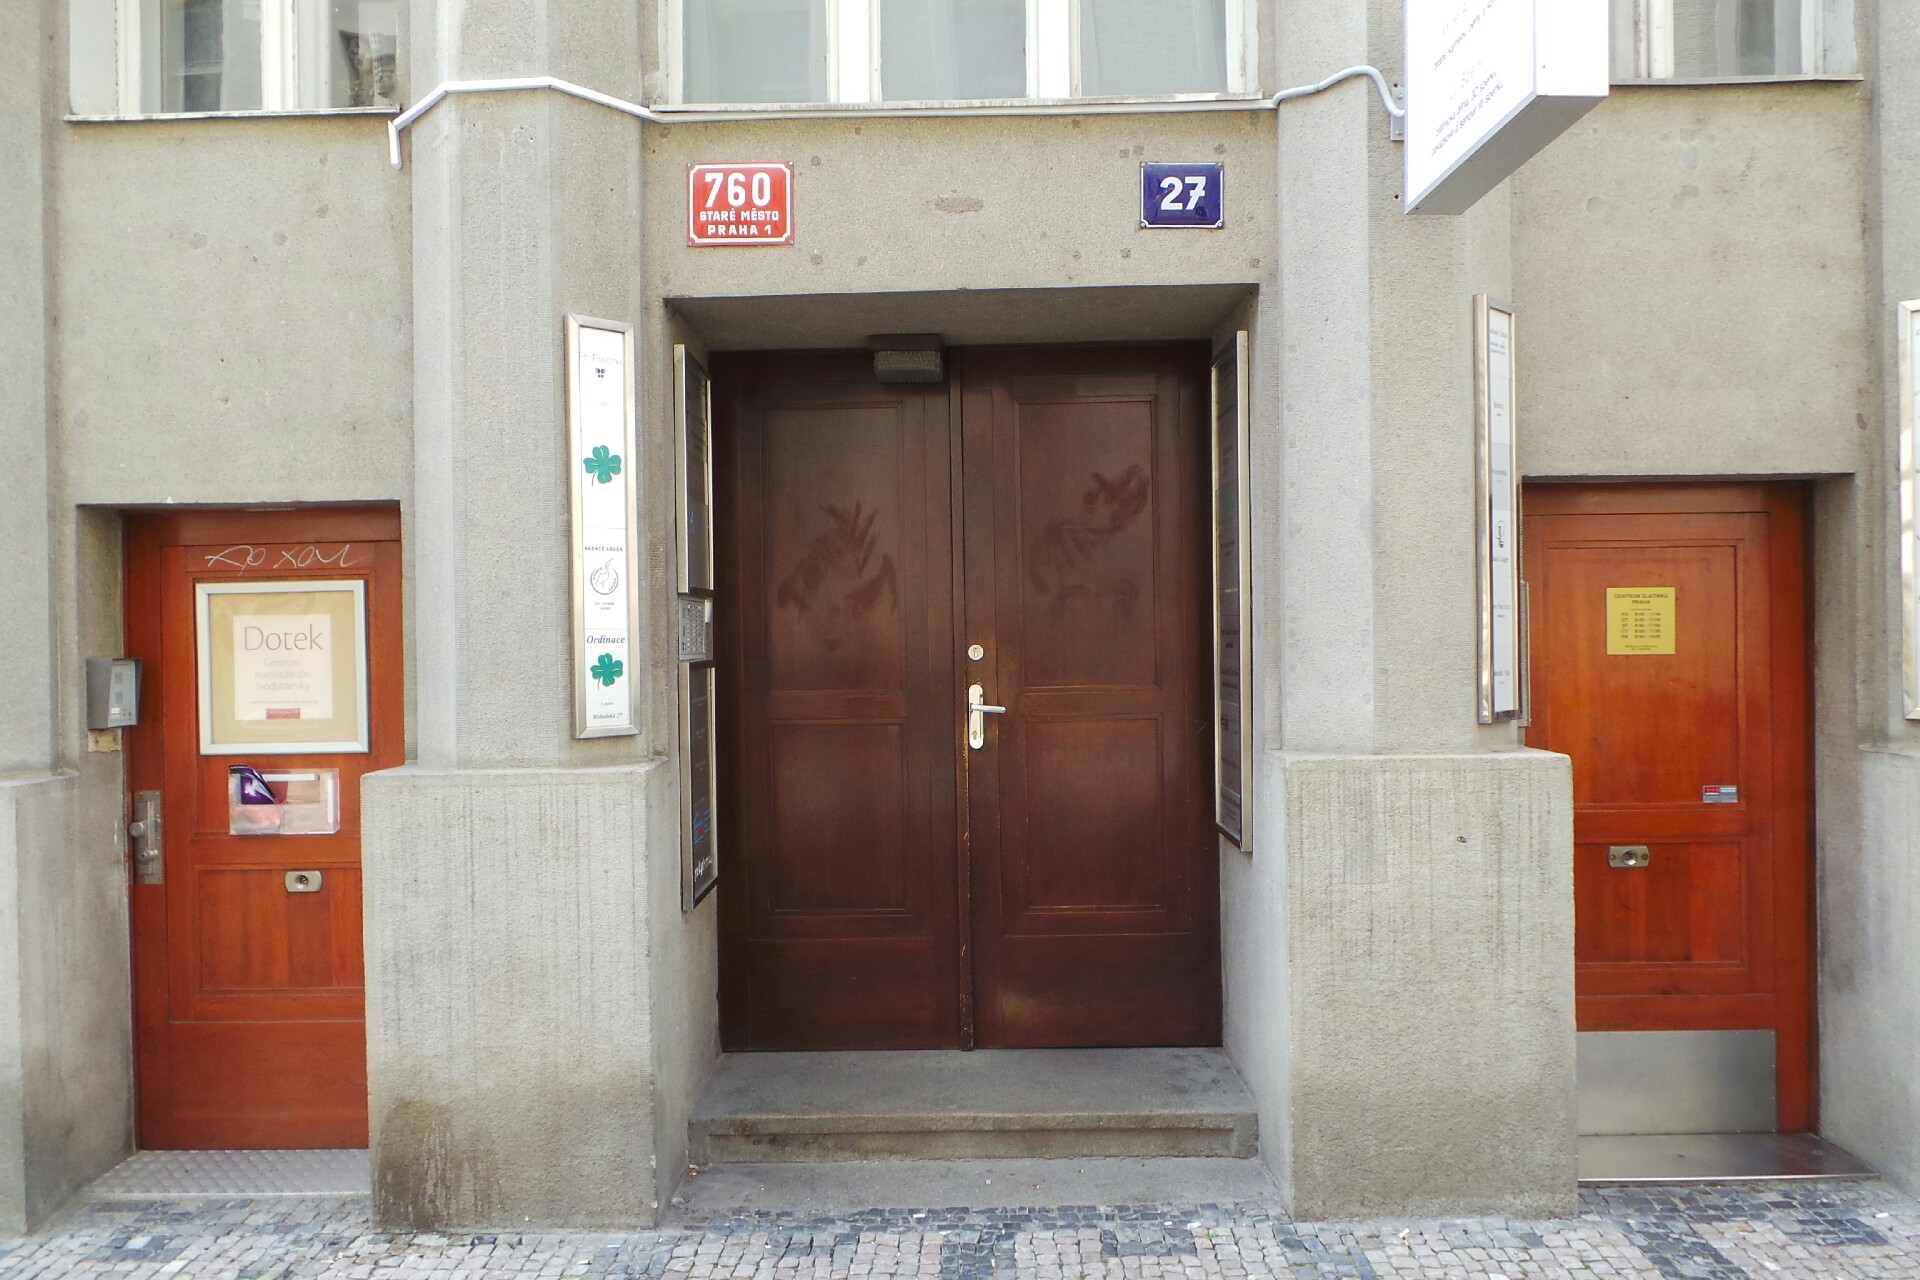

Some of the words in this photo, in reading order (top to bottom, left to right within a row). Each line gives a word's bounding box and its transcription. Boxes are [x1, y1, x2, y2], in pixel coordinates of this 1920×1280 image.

[705, 172, 771, 208] 760
[1160, 176, 1206, 210] 27
[699, 208, 736, 221] STARÉ
[707, 224, 759, 236] PRAHA
[764, 224, 772, 235] 1
[244, 624, 323, 651] Dotek
[586, 635, 626, 644] Ordinace
